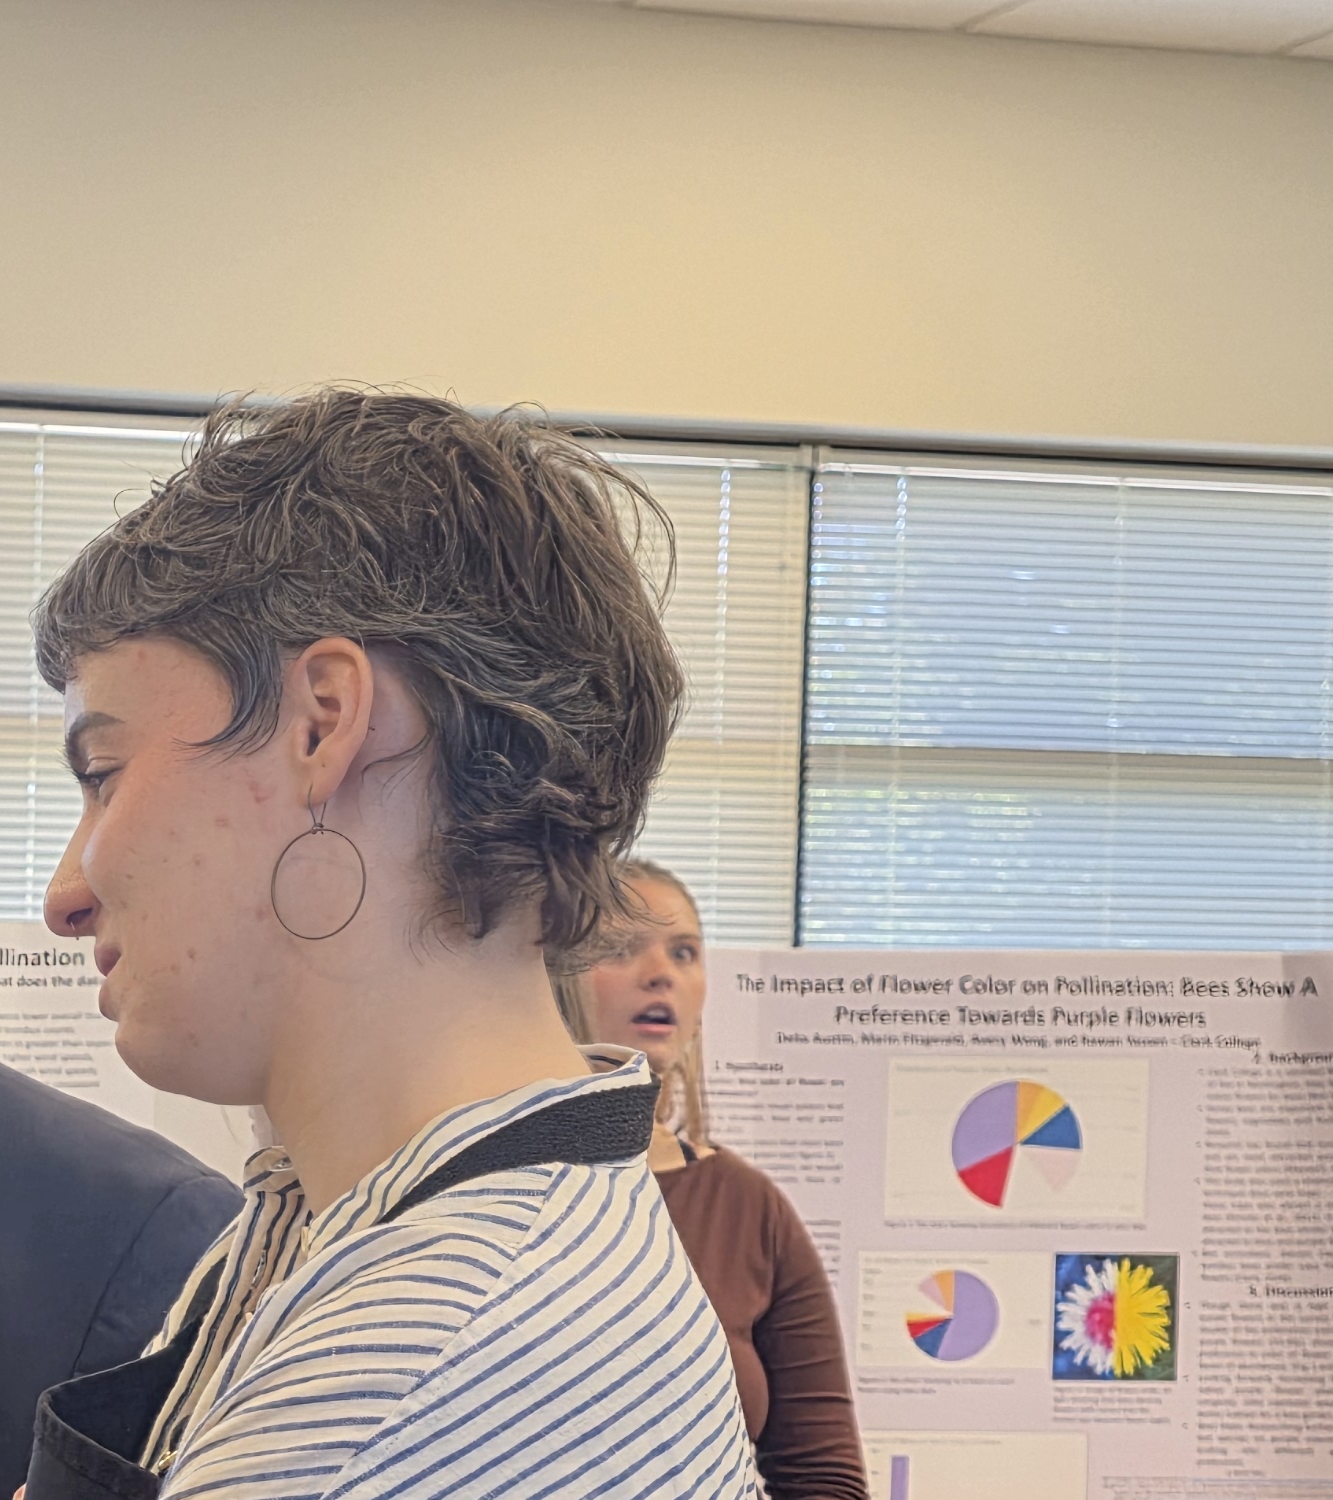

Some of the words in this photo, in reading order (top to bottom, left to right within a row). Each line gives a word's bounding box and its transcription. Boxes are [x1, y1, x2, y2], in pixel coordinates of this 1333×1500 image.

[17, 975, 47, 986] does
[52, 976, 73, 986] the
[77, 976, 100, 986] dat
[736, 974, 765, 993] The
[771, 974, 844, 997] Impact
[851, 974, 875, 994] of
[879, 974, 953, 995] Flower
[959, 974, 1016, 995] Color
[1021, 980, 1048, 996] on
[1183, 976, 1229, 997] Bees
[1236, 977, 1296, 998] Show
[1301, 977, 1318, 997] A
[836, 1006, 950, 1025] Preference
[957, 1006, 1045, 1027] Towards
[1051, 1007, 1119, 1030] Purple
[1126, 1008, 1207, 1027] Flowers
